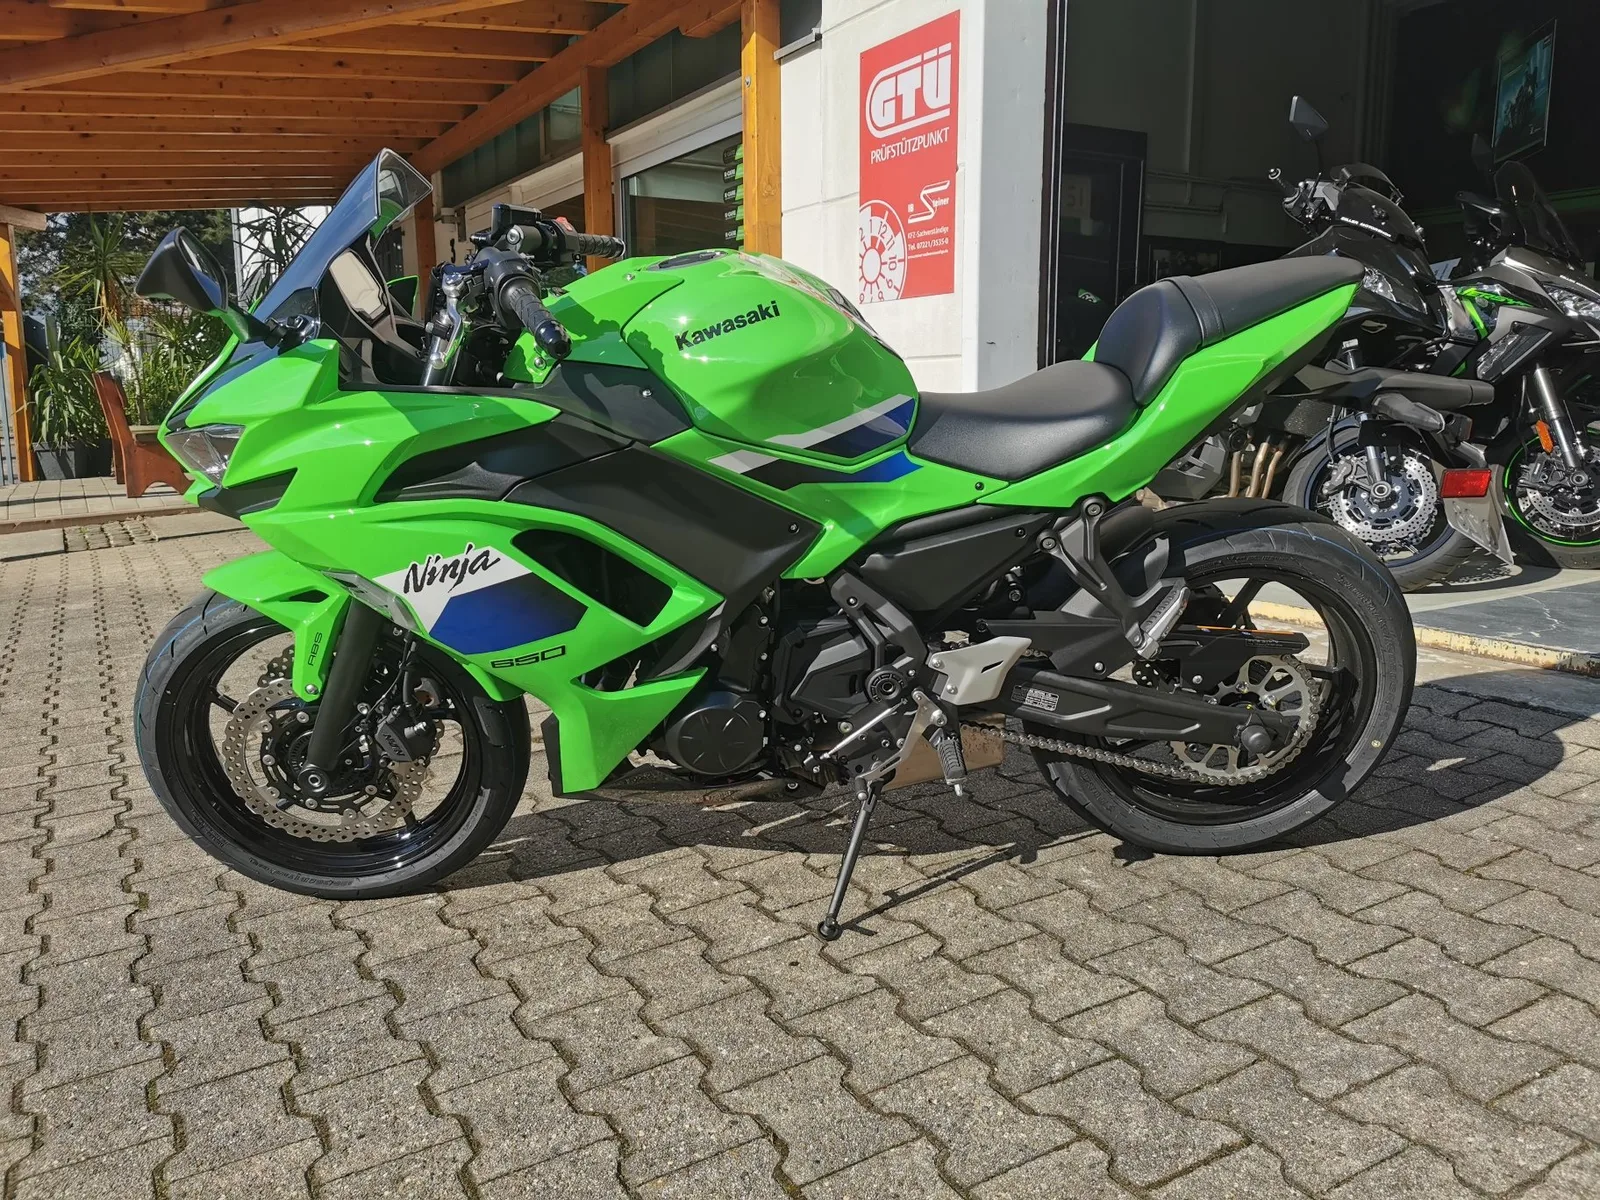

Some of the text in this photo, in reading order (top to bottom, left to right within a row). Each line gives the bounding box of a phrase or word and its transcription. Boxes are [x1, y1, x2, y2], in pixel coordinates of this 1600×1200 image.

[869, 42, 952, 129] GTÜ
[870, 127, 950, 165] PRÜFSTÜTZPUNKT
[674, 300, 780, 352] Kawasaki
[403, 543, 501, 595] Ninja
[307, 631, 323, 667] ABS
[490, 645, 567, 669] 650
